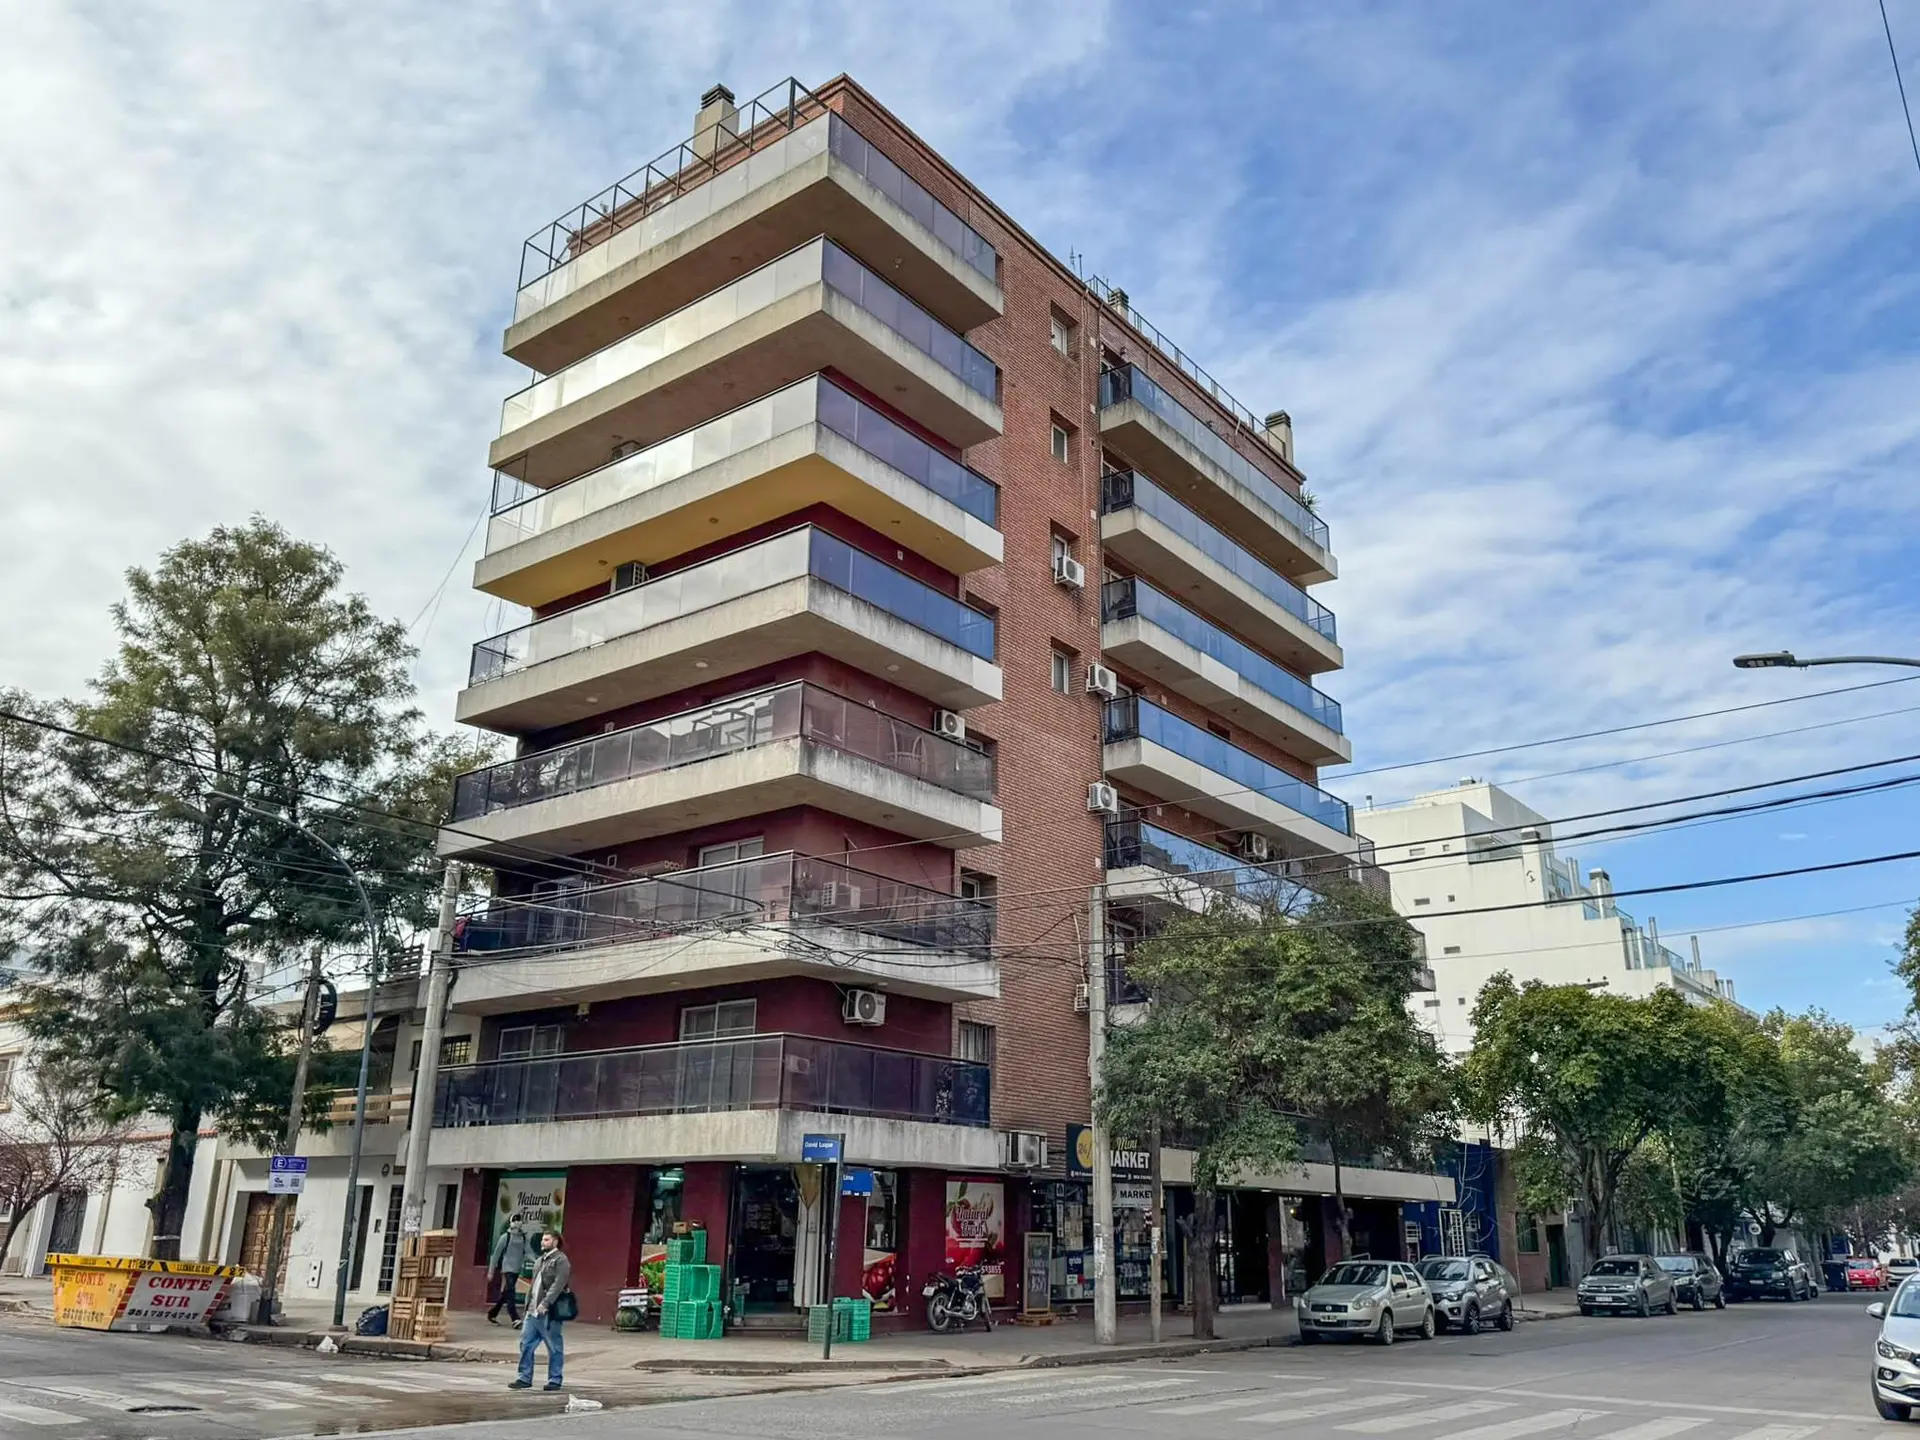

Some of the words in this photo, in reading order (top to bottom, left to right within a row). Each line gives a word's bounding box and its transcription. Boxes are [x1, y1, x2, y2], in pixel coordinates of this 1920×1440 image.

[517, 1191, 551, 1206] Natural
[521, 1206, 544, 1221] Fresh
[956, 1206, 990, 1221] Natural
[75, 1272, 105, 1286] CONTE
[148, 1276, 212, 1291] CONTE
[151, 1294, 191, 1308] SUR
